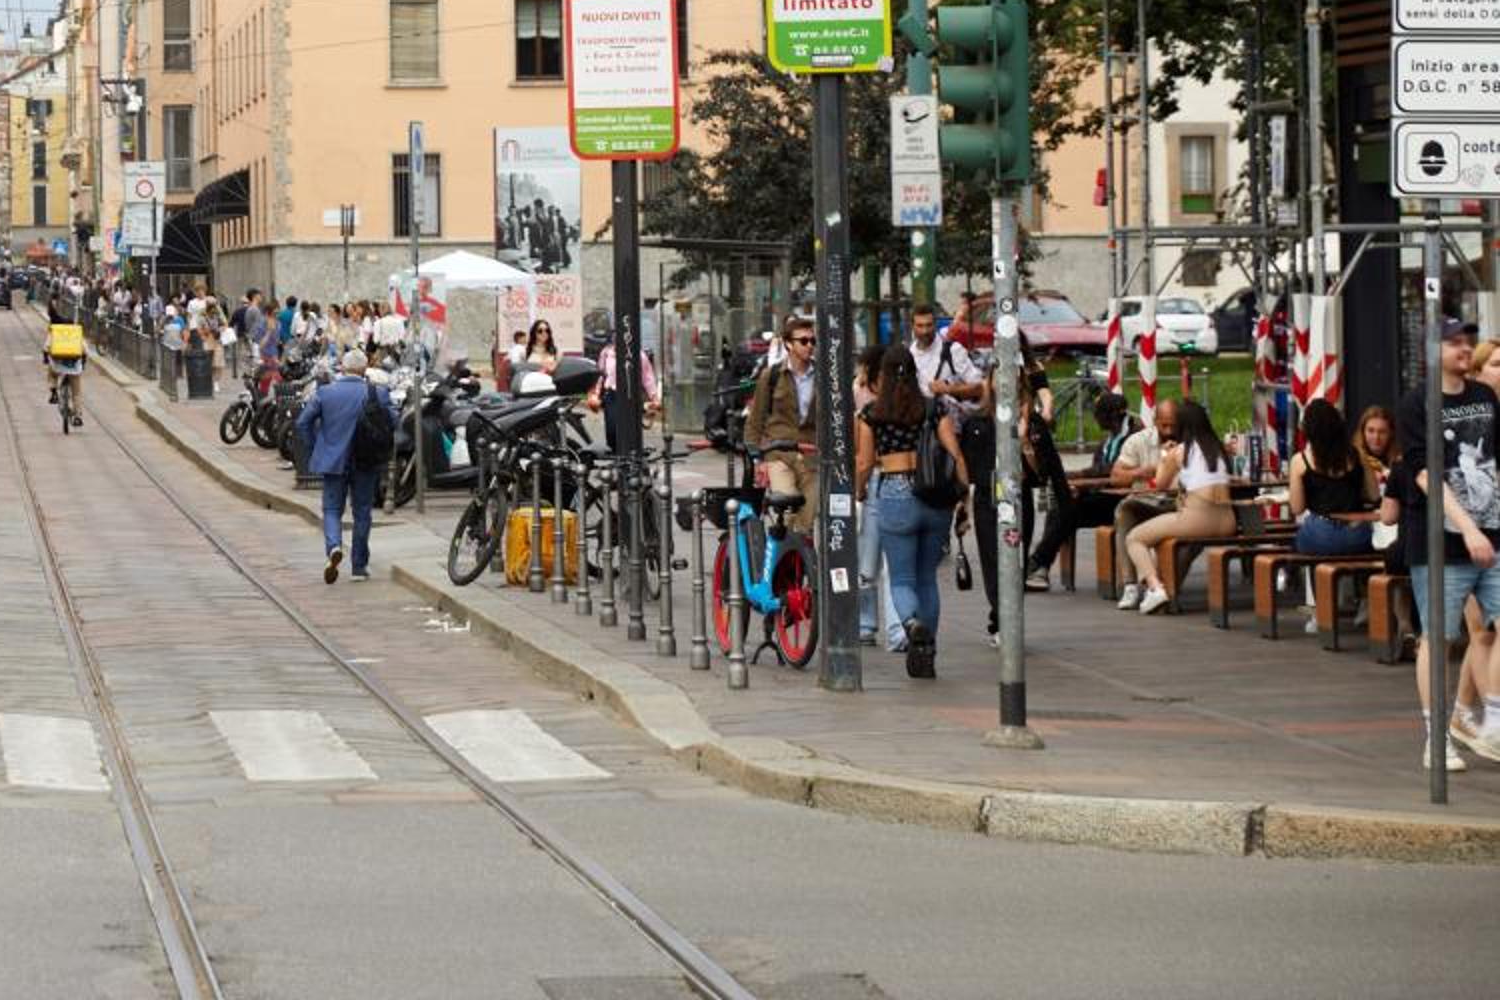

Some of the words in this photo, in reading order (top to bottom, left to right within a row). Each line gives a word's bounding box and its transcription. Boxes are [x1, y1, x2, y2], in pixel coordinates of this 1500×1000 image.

[581, 11, 619, 22] NUOVI
[621, 11, 661, 21] DIVIETI
[1443, 9, 1475, 19] della
[1411, 60, 1453, 73] inizio
[1461, 62, 1499, 73] area
